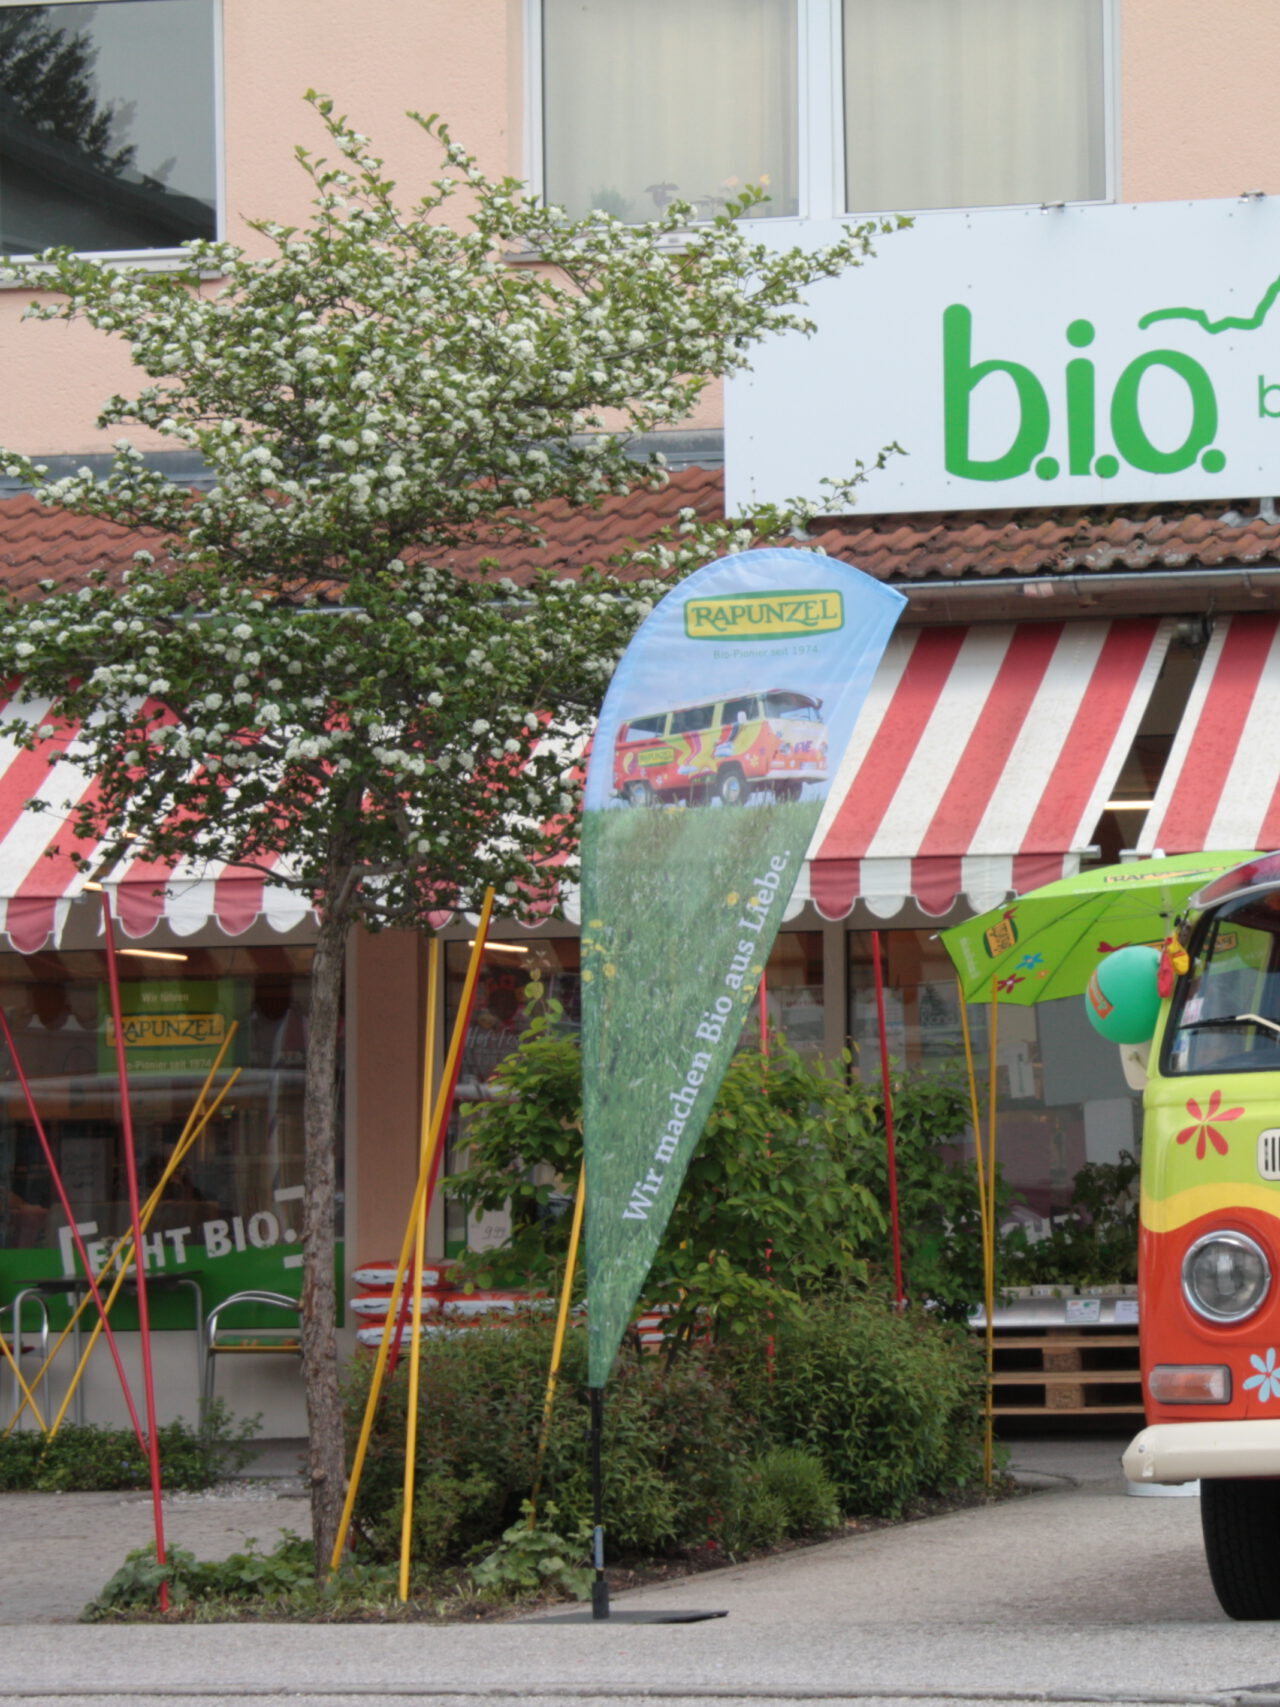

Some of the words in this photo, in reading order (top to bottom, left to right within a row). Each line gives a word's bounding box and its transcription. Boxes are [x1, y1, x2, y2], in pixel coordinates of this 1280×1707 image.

[691, 599, 838, 632] RAPUNZEL
[713, 648, 768, 660] Bio-Pionier
[793, 644, 819, 655] 1974
[738, 850, 791, 935] Liebe.
[725, 939, 755, 990] aus
[696, 995, 733, 1044] Bio
[655, 1051, 713, 1164] machen
[623, 1168, 665, 1220] Wir
